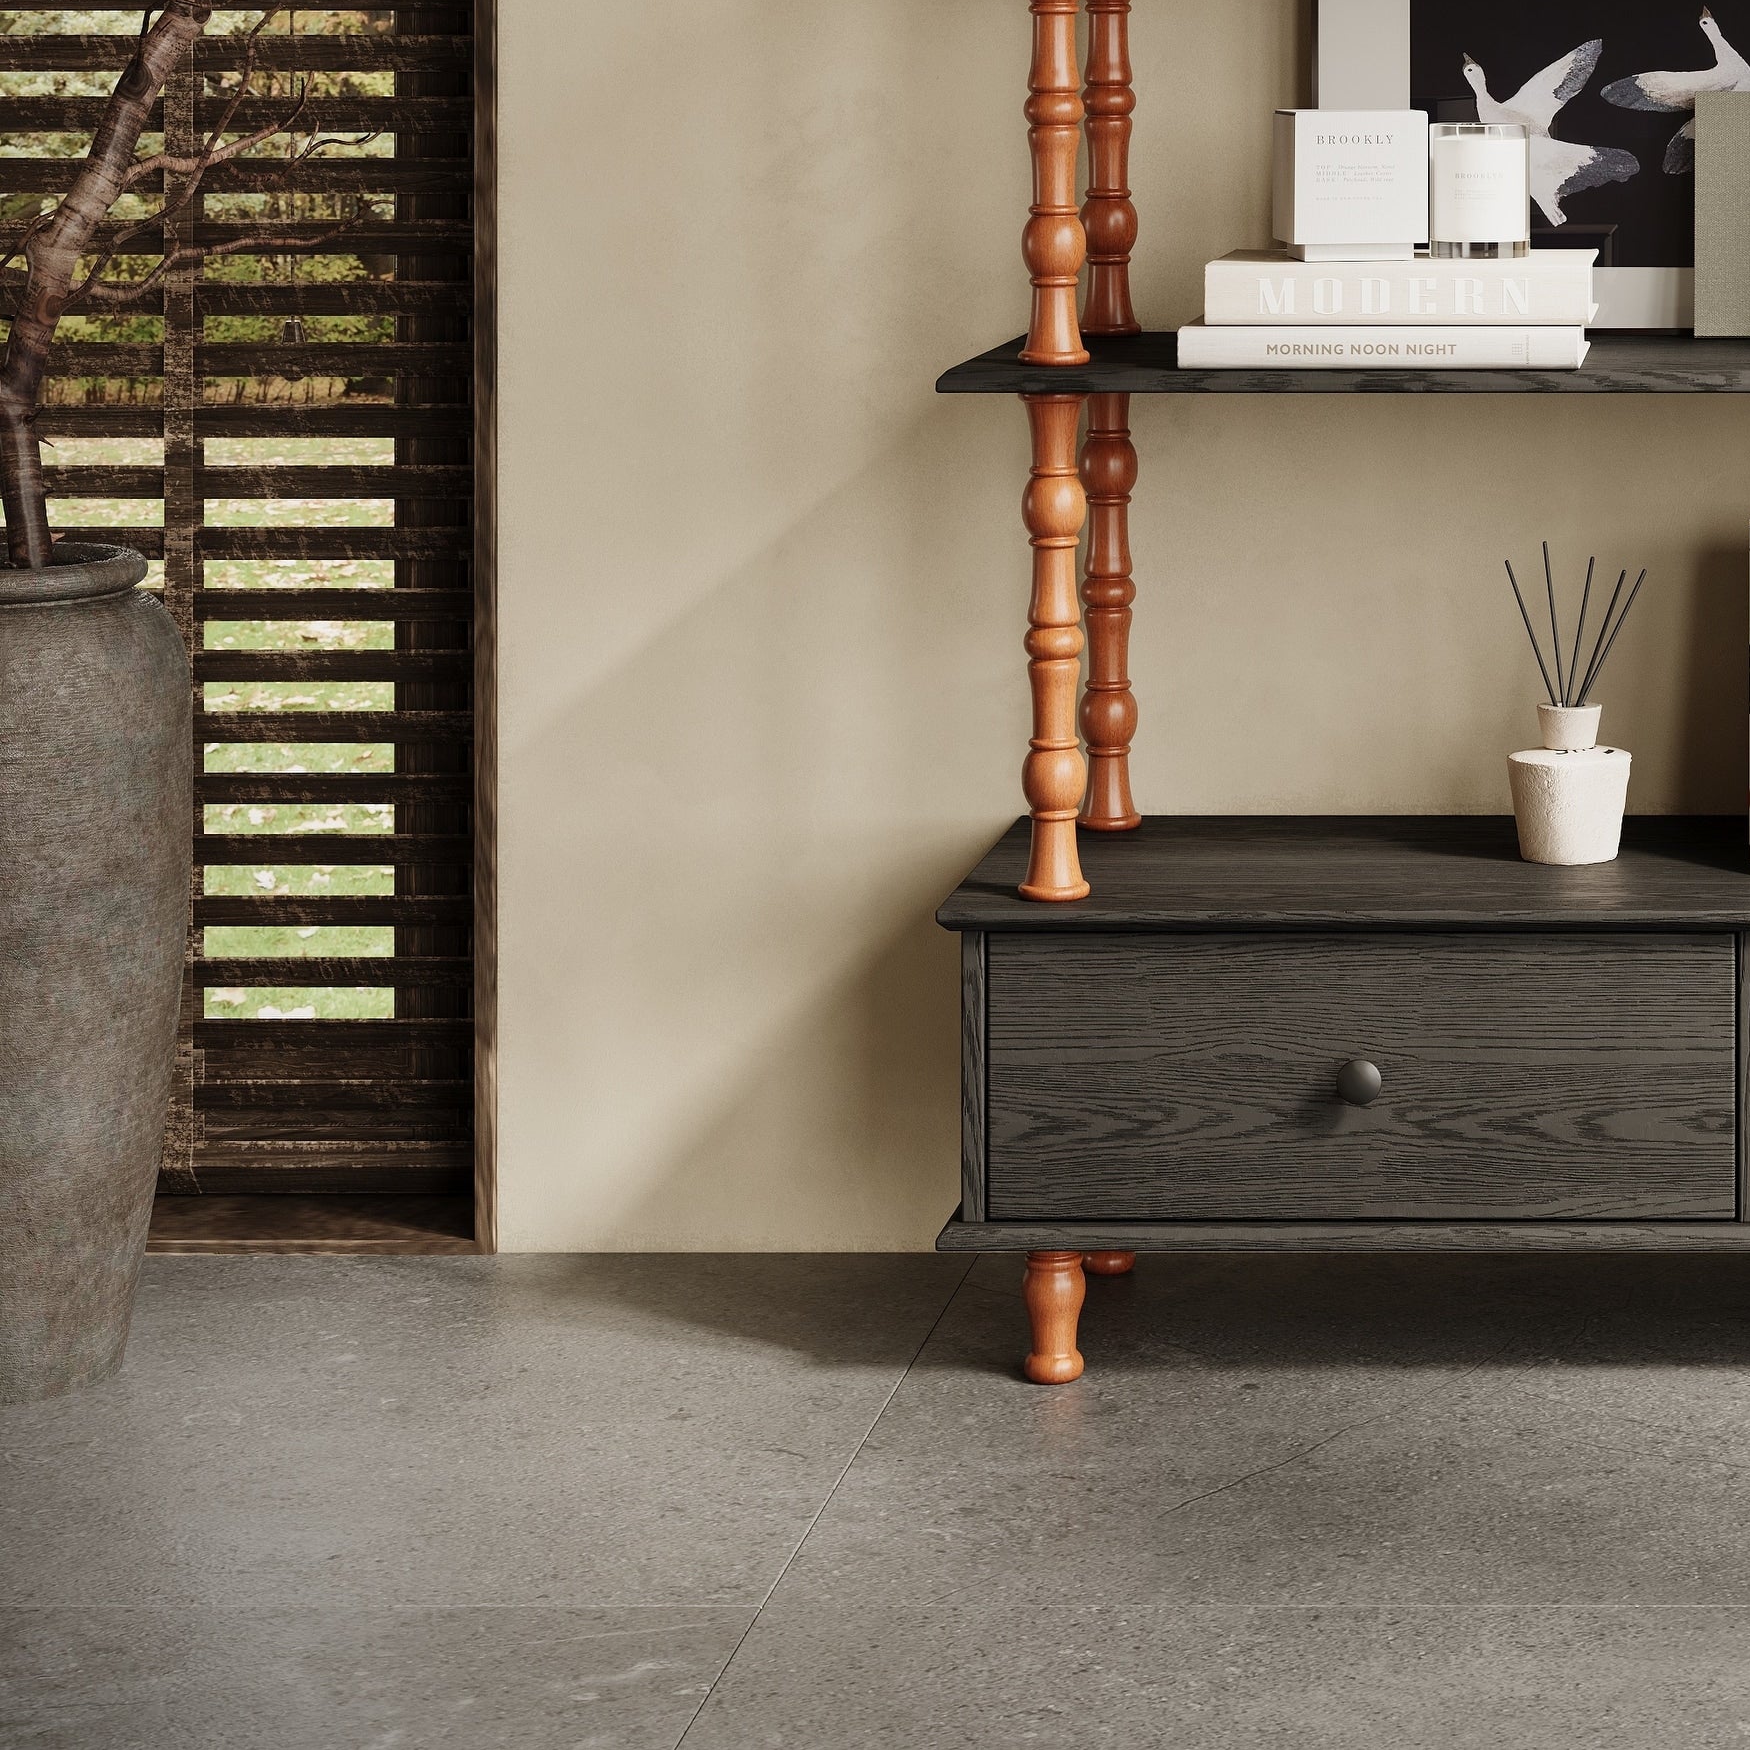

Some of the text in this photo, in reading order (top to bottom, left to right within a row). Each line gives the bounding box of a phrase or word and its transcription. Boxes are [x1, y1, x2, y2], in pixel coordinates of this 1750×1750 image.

[1316, 134, 1393, 145] BROOKLY
[1255, 277, 1532, 315] MODERN
[1266, 343, 1457, 355] MORNING NOON NIGHT
